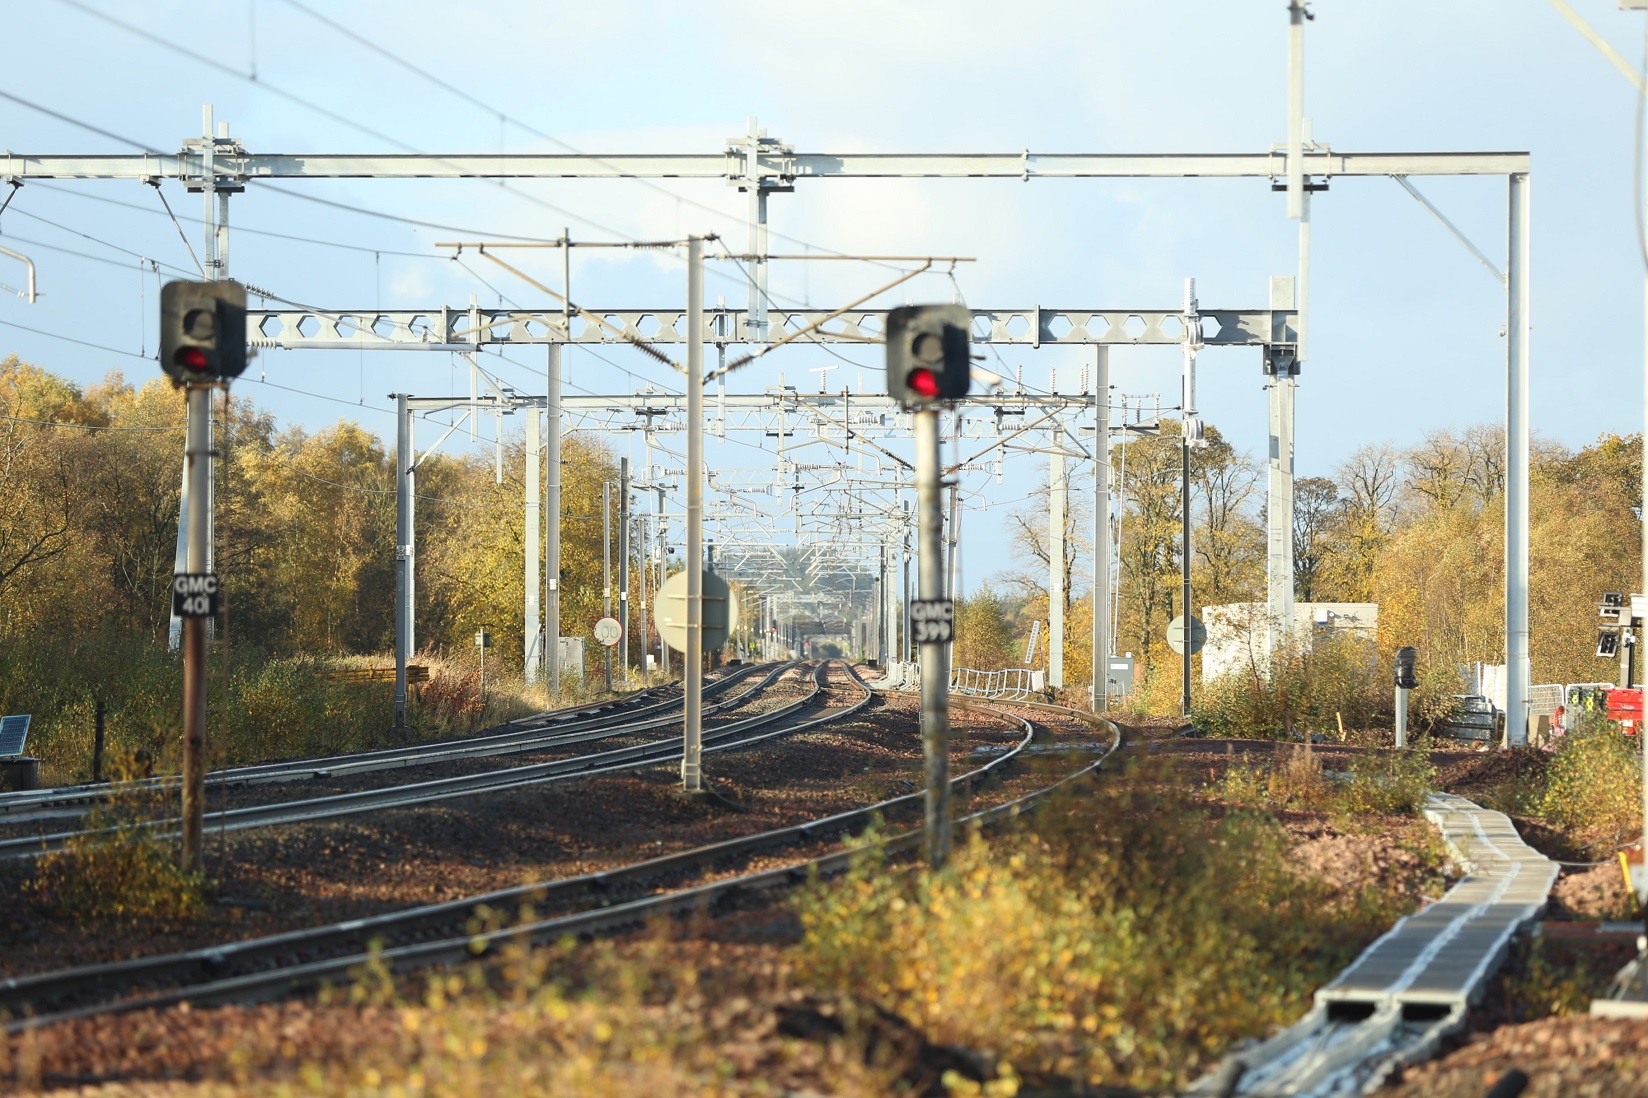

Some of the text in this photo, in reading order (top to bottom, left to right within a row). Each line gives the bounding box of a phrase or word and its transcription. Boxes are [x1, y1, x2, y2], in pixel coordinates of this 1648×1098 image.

[175, 576, 217, 594] GMC
[182, 595, 210, 615] 401
[911, 601, 953, 621] GMC
[913, 619, 951, 642] 399
